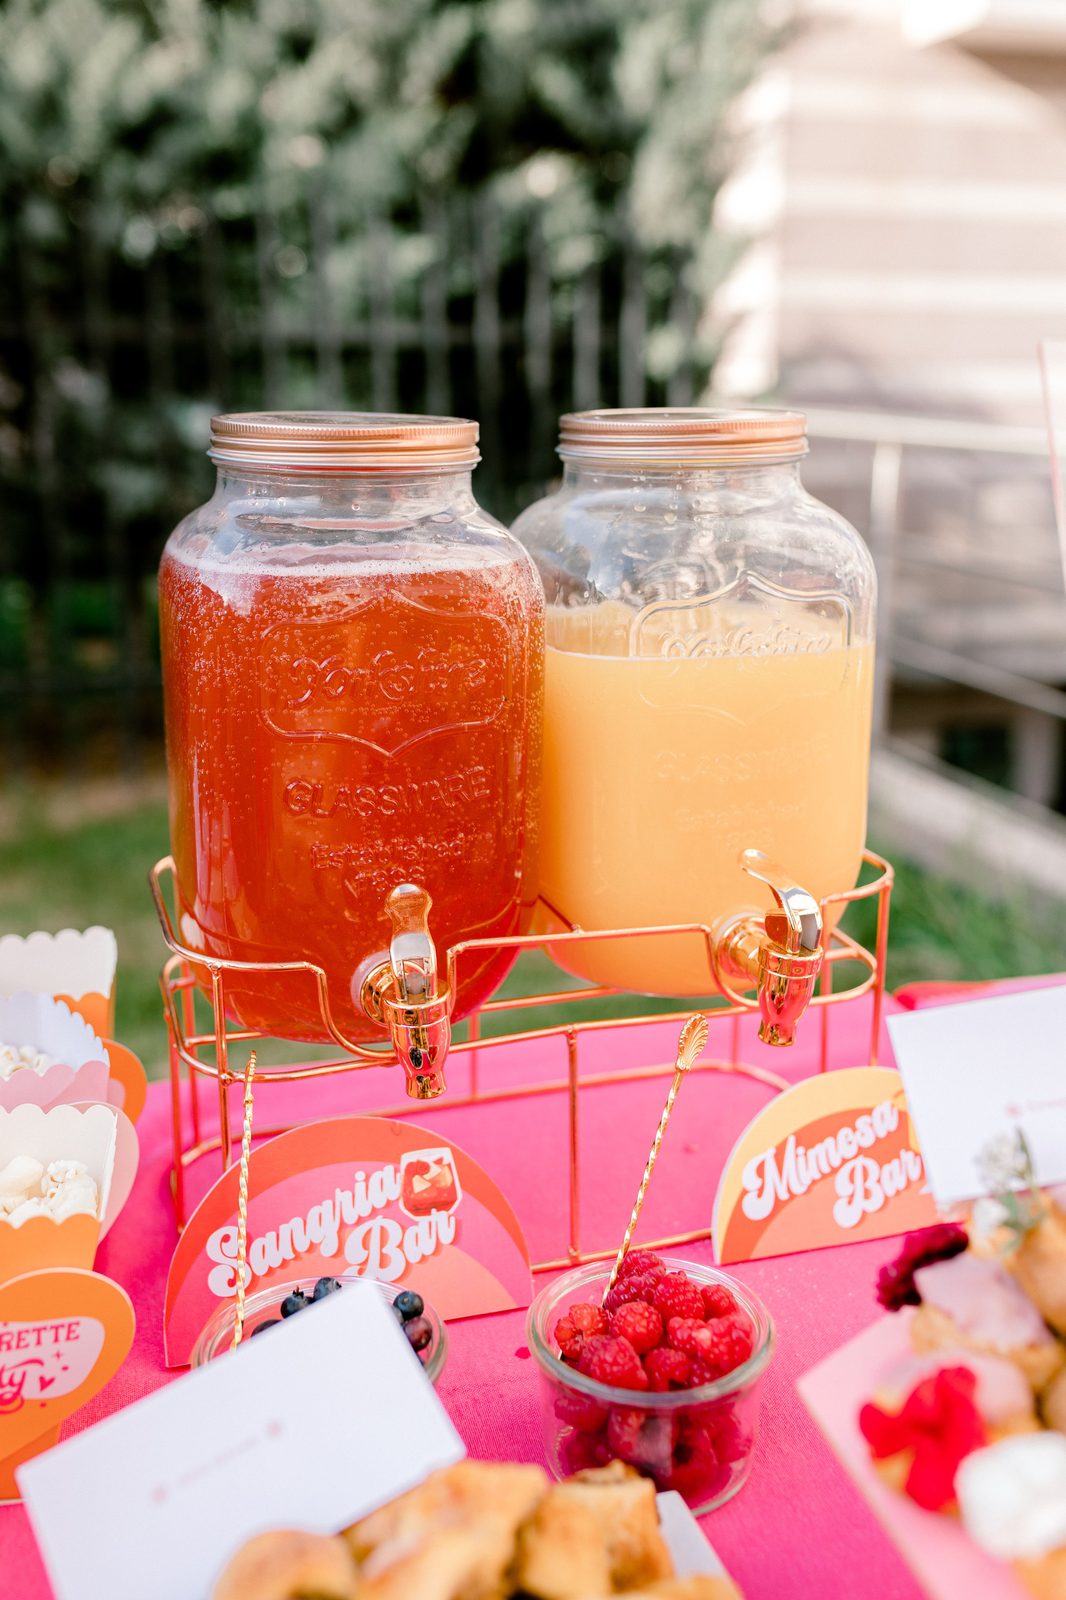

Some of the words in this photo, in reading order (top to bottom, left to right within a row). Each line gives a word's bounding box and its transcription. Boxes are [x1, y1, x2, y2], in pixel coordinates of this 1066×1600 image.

[282, 764, 491, 819] GLASSWARE
[742, 1101, 899, 1221] Mimosa
[833, 1149, 922, 1228] Bar
[206, 1165, 401, 1297] Sangria
[342, 1208, 456, 1282] Bar
